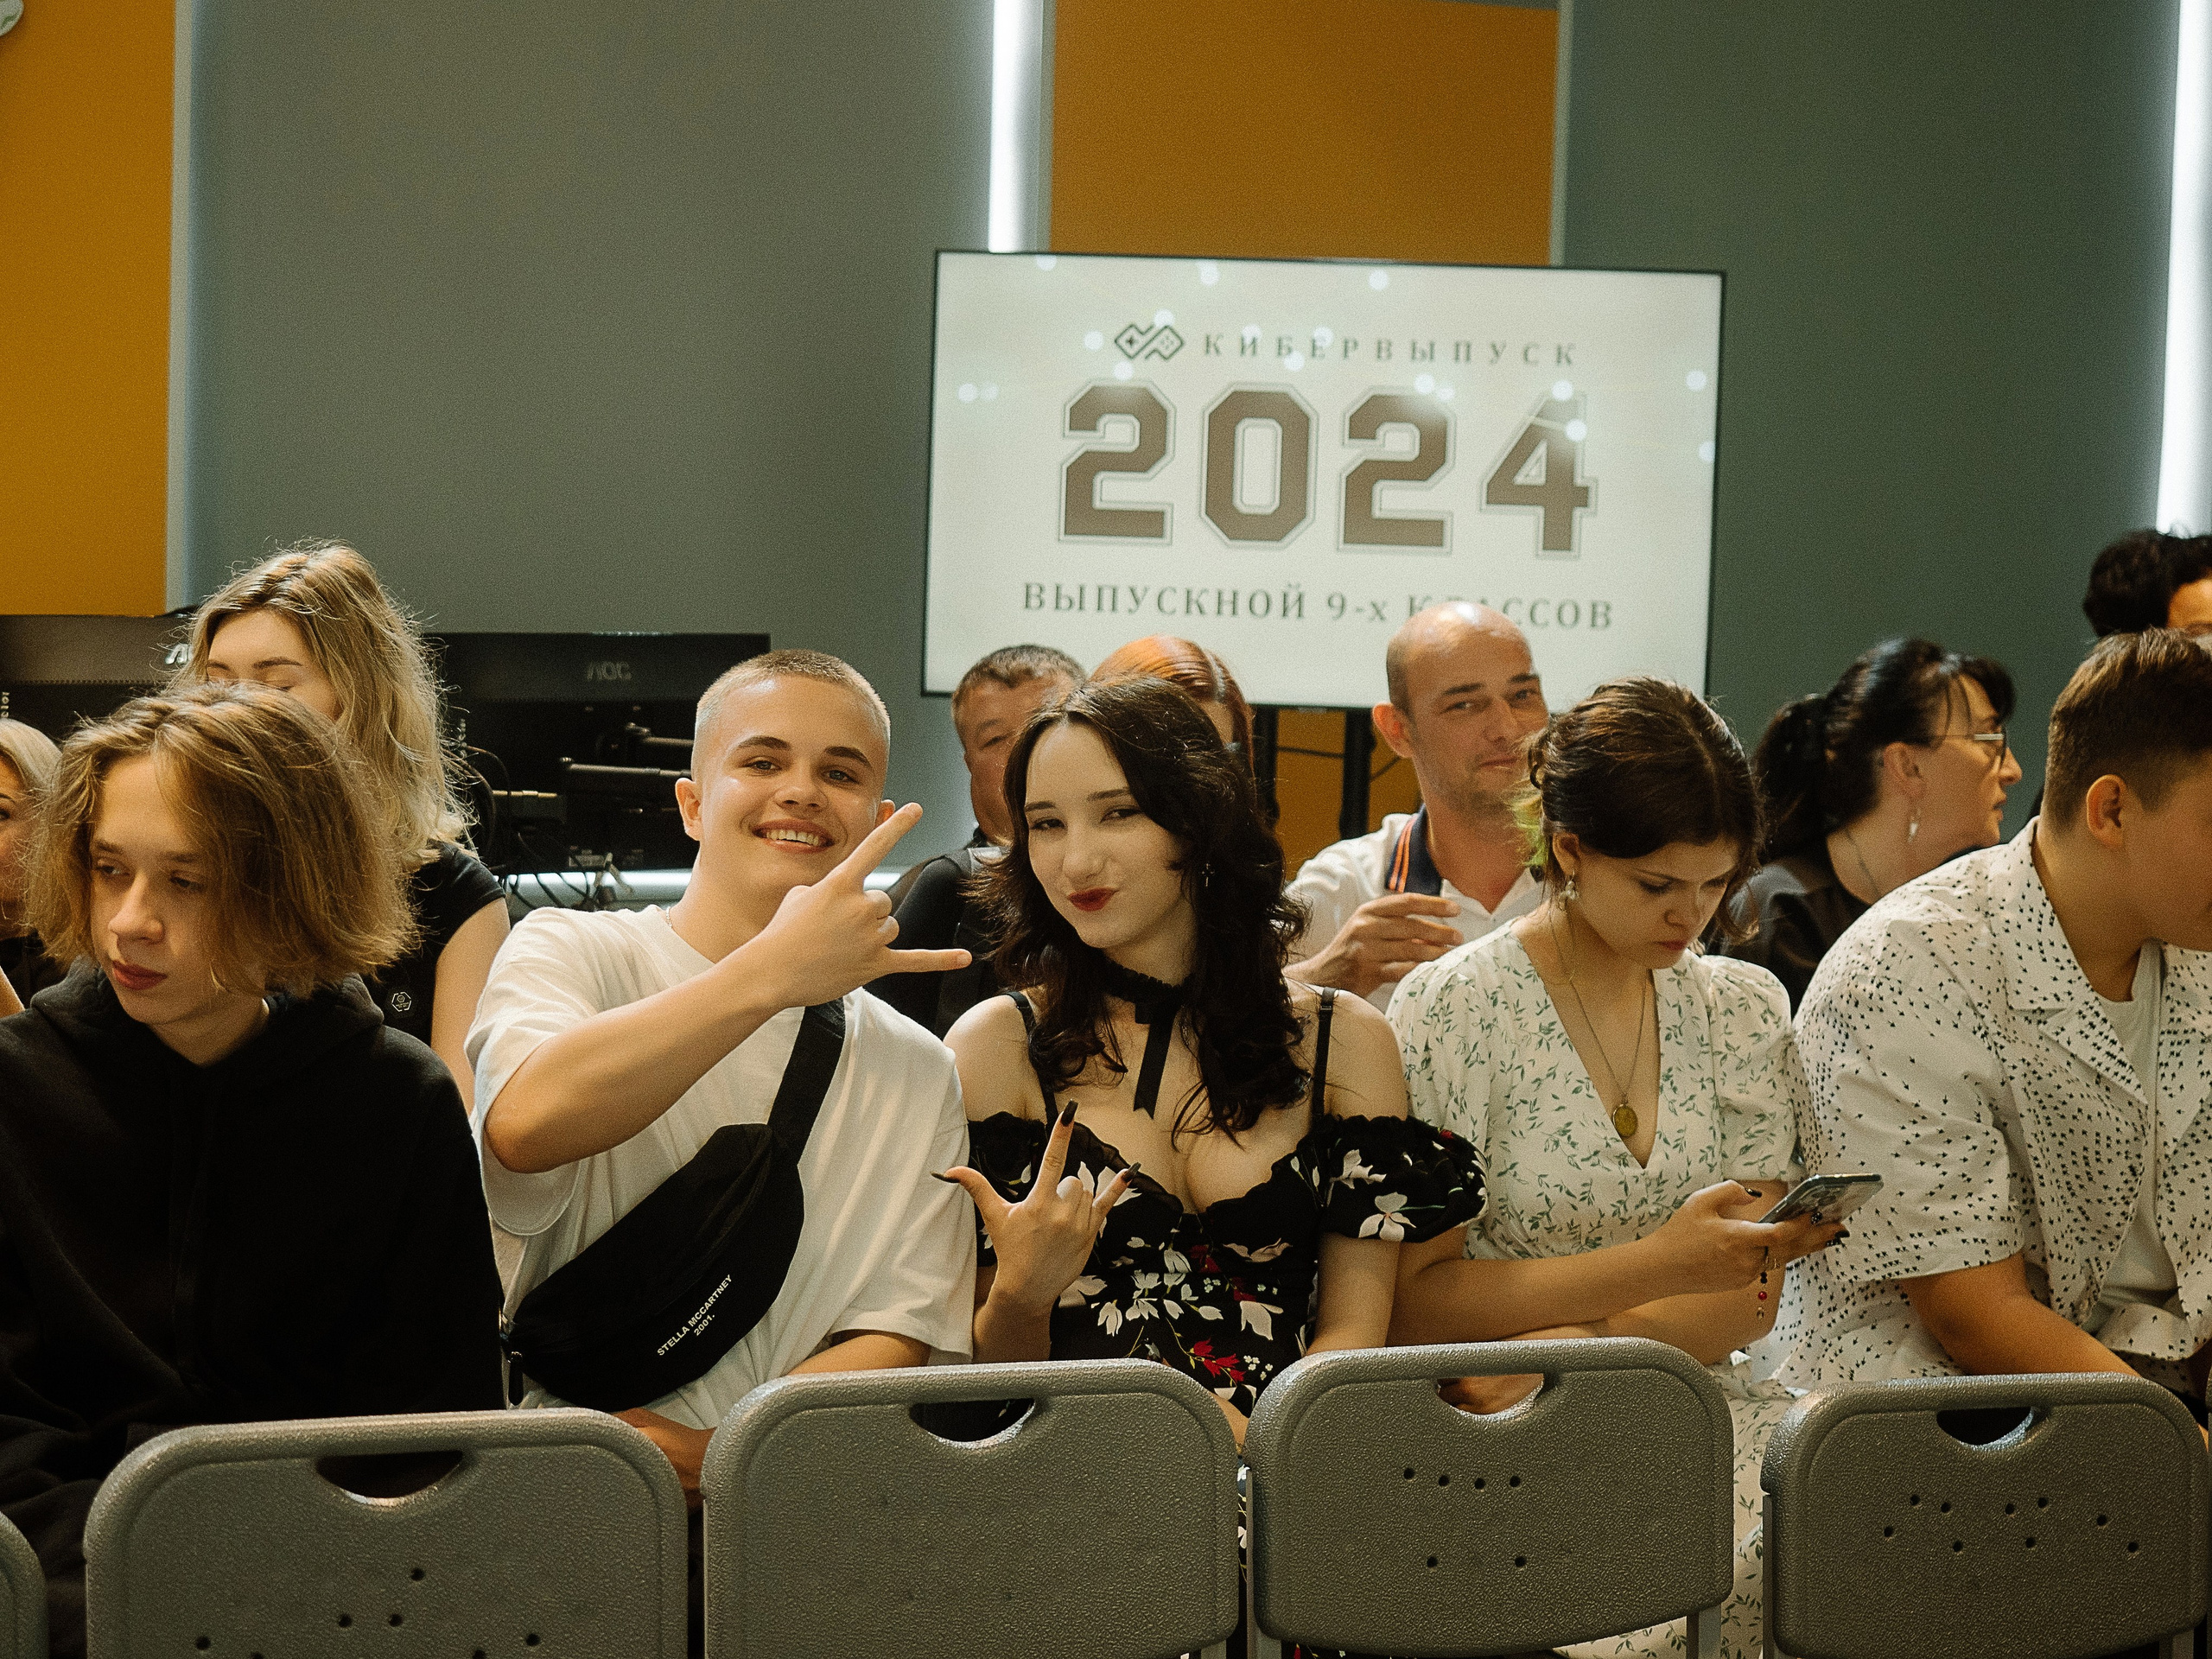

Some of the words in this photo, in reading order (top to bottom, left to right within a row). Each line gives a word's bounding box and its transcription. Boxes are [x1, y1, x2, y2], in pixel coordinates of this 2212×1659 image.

[1205, 333, 1575, 366] КИБЕРВЫПУСК
[1058, 378, 1599, 559] 2024
[1024, 582, 1305, 620] ВЫПУСКНОЙ
[1408, 594, 1613, 630] КССОВ
[657, 1325, 690, 1356] STELLA
[688, 1274, 733, 1327] MCCARTNEY
[693, 1313, 715, 1336] 2001.
